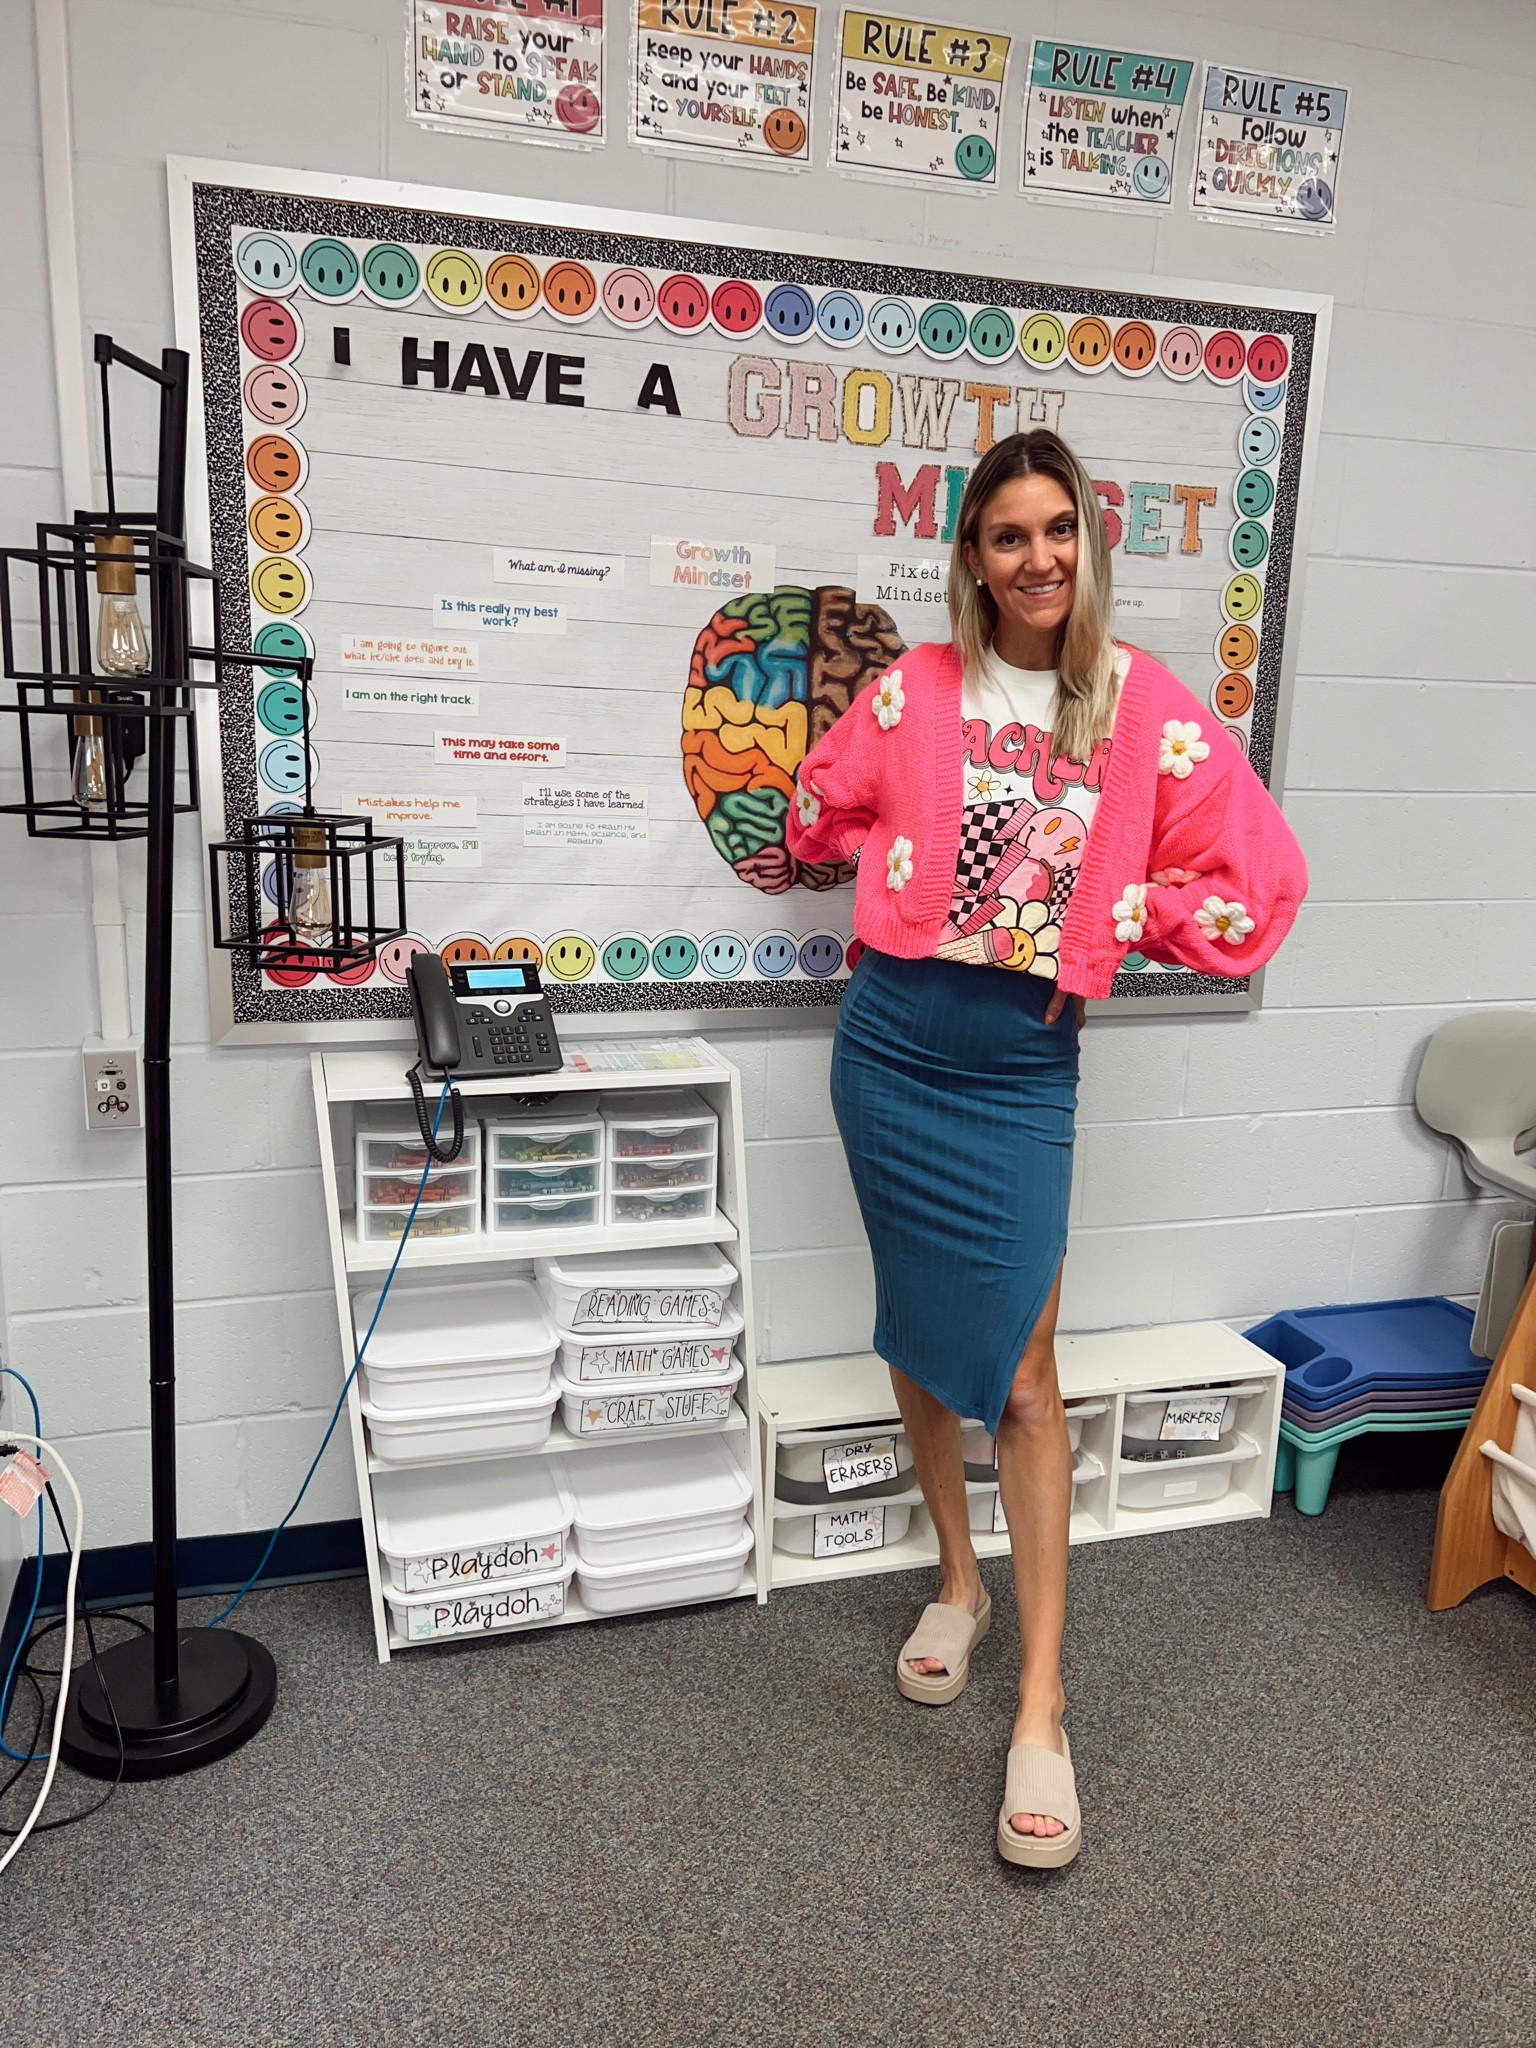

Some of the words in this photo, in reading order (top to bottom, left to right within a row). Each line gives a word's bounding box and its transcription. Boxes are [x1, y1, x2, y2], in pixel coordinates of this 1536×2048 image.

[446, 12, 509, 45] RAISE
[518, 29, 574, 54] your
[661, 0, 738, 37] RULE
[752, 9, 797, 44] #2
[422, 36, 484, 66] HAND
[493, 49, 518, 71] to
[526, 52, 598, 83] SPEAK
[647, 38, 692, 68] keep
[700, 52, 744, 71] your
[750, 54, 808, 81] HANDS
[864, 20, 936, 64] RULE
[950, 38, 991, 73] #3
[1052, 48, 1122, 90] RULE
[1132, 64, 1176, 98] #4
[440, 71, 468, 89] or
[477, 71, 551, 104] STAND.
[662, 72, 698, 92] and
[706, 80, 748, 100] your
[755, 83, 790, 106] FEET
[846, 71, 866, 91] Be
[872, 72, 922, 102] SAFE,
[927, 84, 947, 102] Be
[952, 84, 1000, 113] KIND,
[1222, 74, 1286, 114] RULE
[1295, 92, 1330, 122] #5
[650, 94, 668, 113] to
[676, 98, 762, 128] YOURSELF.
[862, 101, 883, 120] be
[888, 101, 962, 134] HONEST.
[1049, 96, 1106, 122] LISTEN
[1112, 105, 1163, 130] when
[1047, 122, 1079, 144] the
[1086, 126, 1159, 155] TEACHER
[1242, 117, 1306, 148] Follow
[1040, 148, 1054, 166] is
[1061, 148, 1130, 178] TALKING.
[1215, 138, 1322, 176] DIRECTIONS
[1212, 166, 1292, 199] QUICKLY
[333, 327, 351, 366] I
[402, 337, 585, 407] HAVE
[637, 363, 681, 416] A
[728, 355, 1065, 456] GROWTH
[873, 461, 1217, 554] MISET
[676, 540, 751, 564] Growth
[508, 559, 536, 572] What
[538, 564, 554, 573] am
[558, 564, 566, 574] I
[567, 566, 610, 582] missing?
[674, 566, 752, 588] Mindset
[889, 563, 940, 580] Fixed
[876, 586, 948, 604] Mindset
[1115, 598, 1131, 607] give
[1132, 600, 1144, 608] up.
[441, 600, 452, 610] Is
[456, 600, 476, 612] this
[479, 604, 510, 616] really
[514, 607, 530, 618] my
[534, 606, 558, 618] best
[482, 616, 518, 628] work?
[352, 639, 356, 648] I
[360, 640, 373, 648] am
[406, 642, 416, 650] to
[452, 645, 468, 654] out
[370, 652, 400, 663] he/she
[404, 654, 424, 664] does
[346, 689, 350, 699] I
[352, 692, 370, 700] am
[374, 692, 387, 701] on
[390, 691, 408, 702] the
[410, 692, 438, 704] right
[440, 694, 474, 705] track.
[442, 738, 466, 747] This
[469, 739, 496, 750] may
[498, 740, 524, 750] take
[528, 742, 560, 751] some
[453, 750, 480, 760] time
[484, 752, 507, 761] and
[510, 752, 549, 762] effort.
[358, 797, 412, 808] Mistakes
[415, 799, 440, 810] help
[443, 800, 460, 808] me
[524, 796, 574, 808] strategies
[576, 799, 580, 807] I
[584, 799, 605, 808] have
[608, 800, 646, 809] learned.
[539, 788, 551, 797] I'll
[554, 790, 572, 798] use
[575, 790, 599, 799] some
[602, 791, 613, 799] of
[616, 790, 630, 800] the
[386, 810, 433, 822] improve.
[384, 852, 408, 862] kep
[411, 852, 445, 865] trying.
[418, 840, 459, 853] improve.
[462, 840, 478, 850] I'll
[588, 1294, 651, 1317] READING
[660, 1294, 708, 1318] GAMES
[614, 1350, 652, 1372] MATH
[662, 1345, 710, 1370] GAMES
[607, 1399, 655, 1424] CRAFT
[666, 1393, 712, 1419] STUFF
[1166, 1412, 1221, 1424] MARKERS
[846, 1443, 874, 1457] DRY
[830, 1456, 892, 1483] ERASERS
[830, 1511, 868, 1526] MATH
[824, 1529, 873, 1547] TOOLS
[432, 1542, 538, 1580] Playdoh
[435, 1590, 540, 1629] Playdoh
